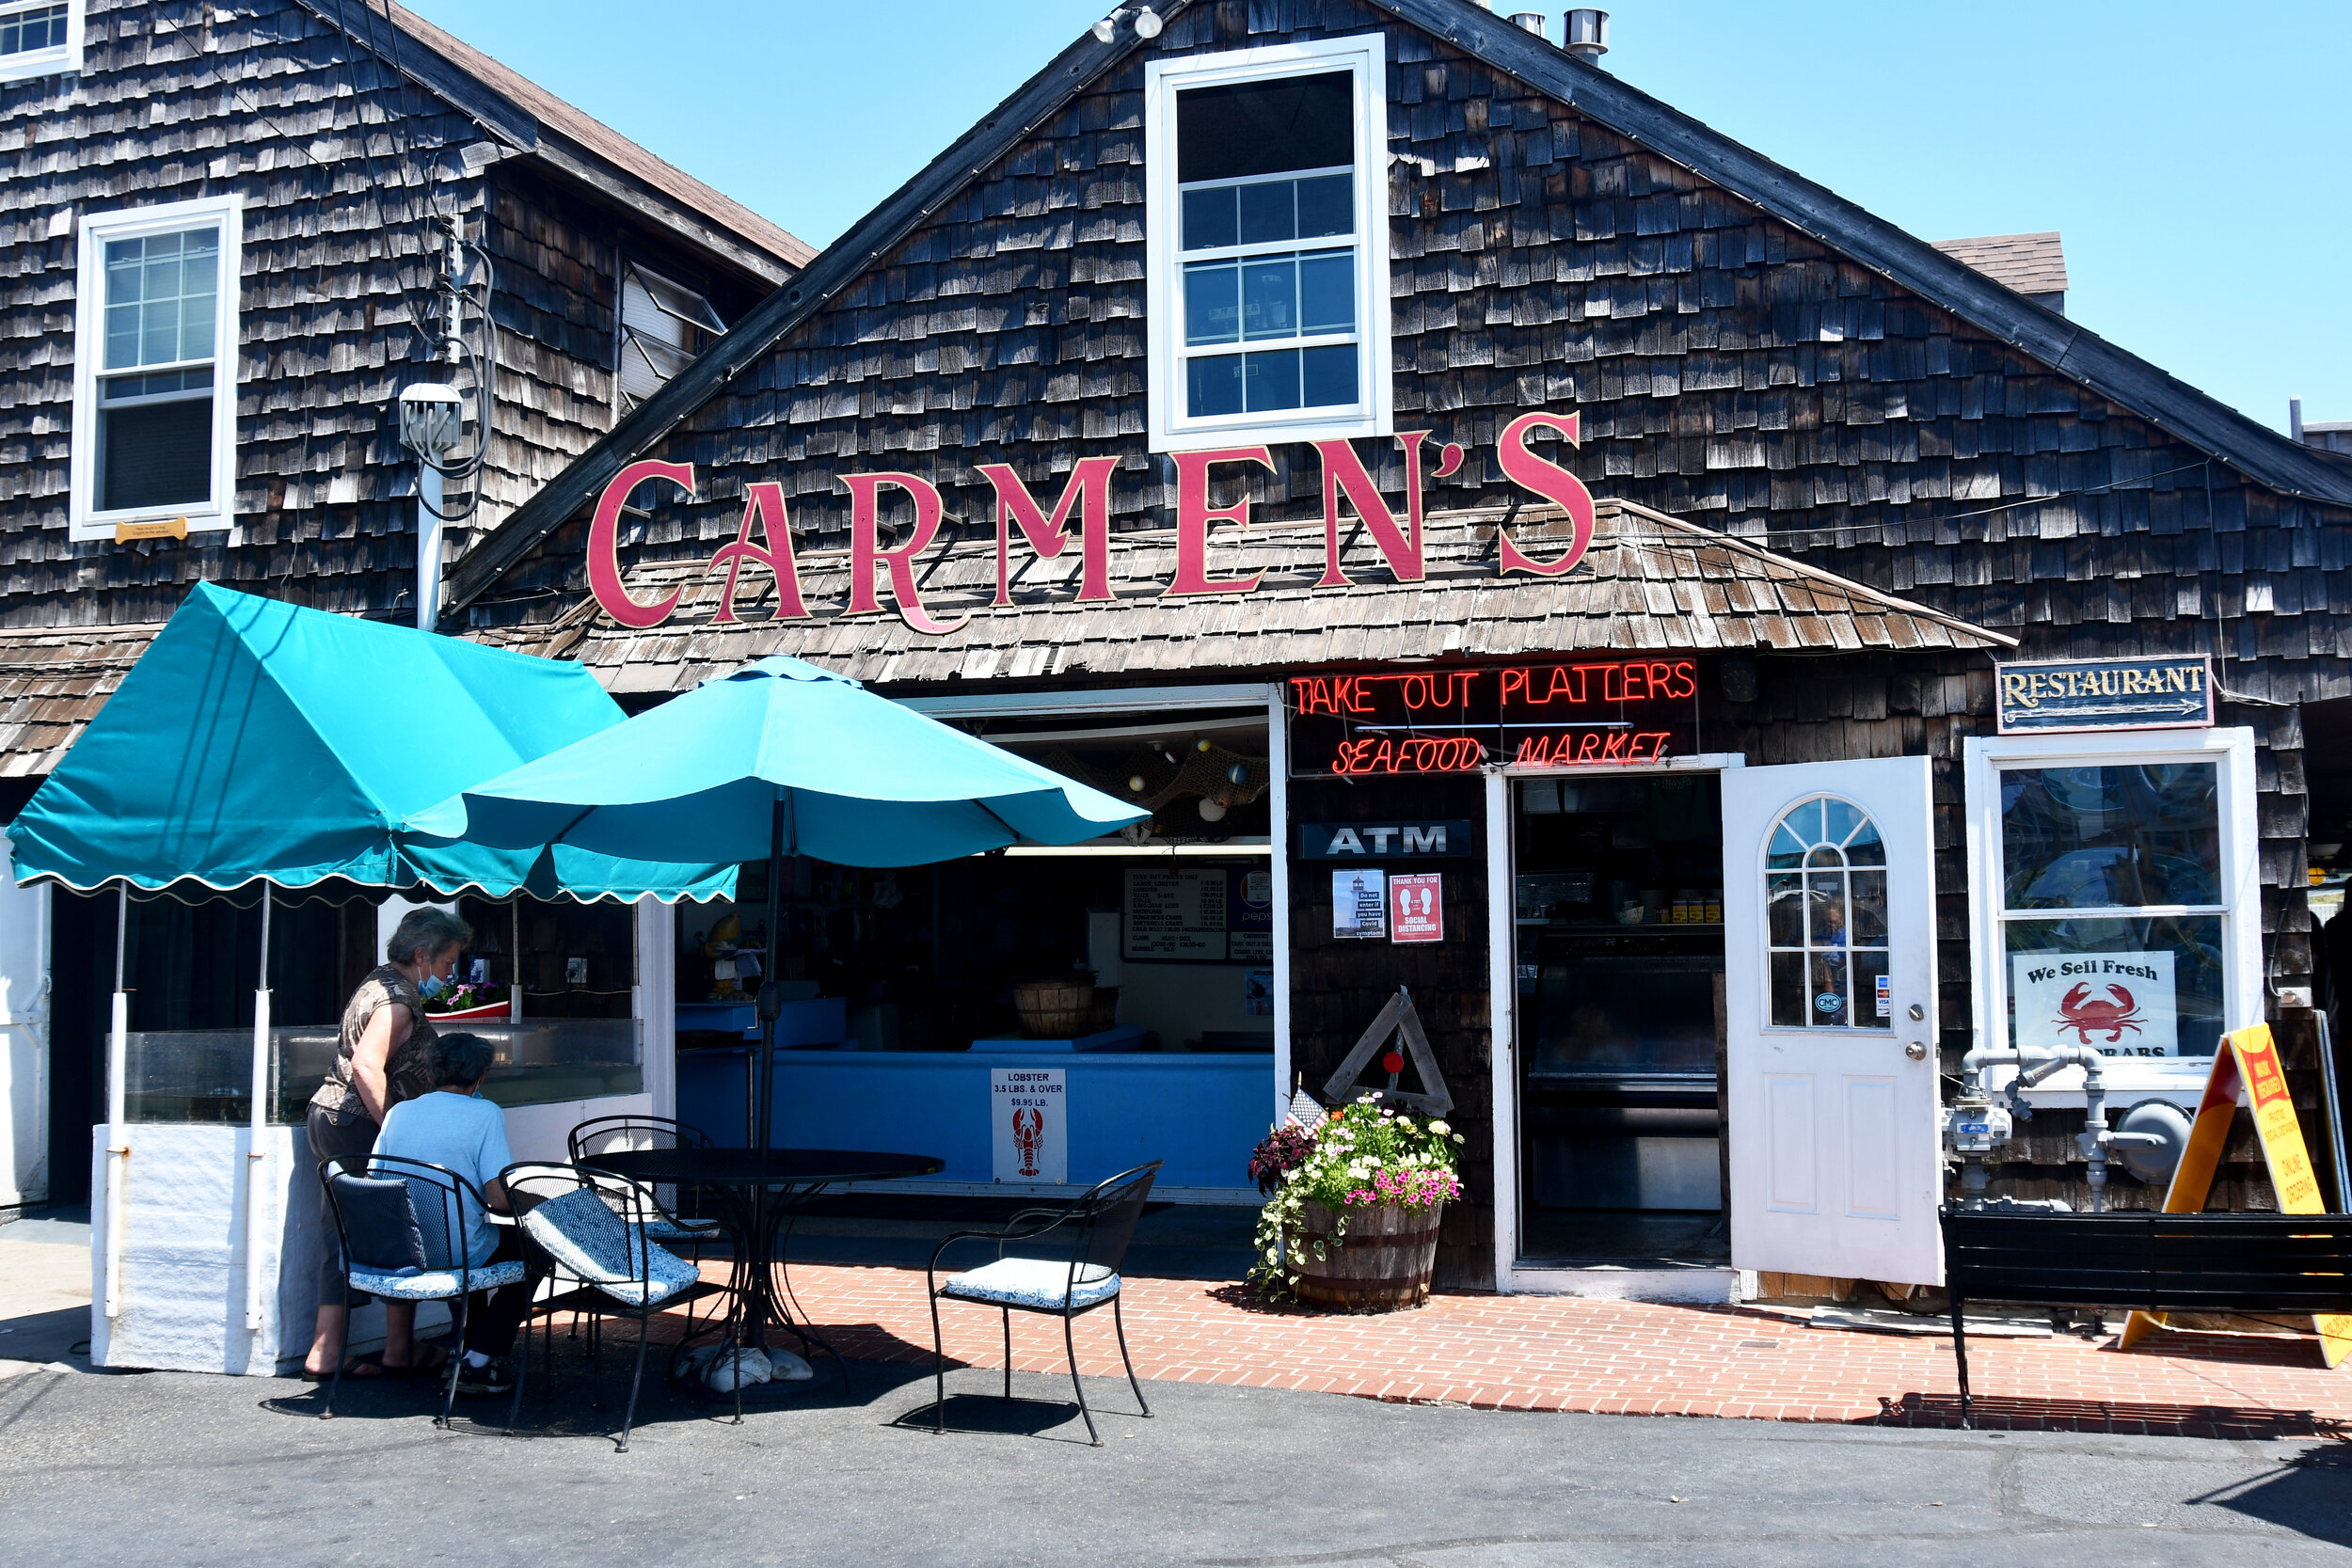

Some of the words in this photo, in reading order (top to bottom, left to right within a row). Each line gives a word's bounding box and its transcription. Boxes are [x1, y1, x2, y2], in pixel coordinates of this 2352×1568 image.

[585, 410, 1596, 635] CARMEN'S
[1291, 675, 1375, 715] TAKE
[1404, 673, 1480, 709] OUT
[1502, 662, 1695, 706] PLATTERS
[2002, 666, 2204, 708] RESTAURANT
[1332, 737, 1482, 774] SEAFOOD
[1516, 733, 1671, 768] MARKET
[1326, 826, 1448, 855] ATM
[1398, 924, 1437, 932] DISTANCING
[1405, 916, 1428, 925] SOCIAL
[2027, 967, 2056, 984] We
[2060, 960, 2098, 976] Sell
[2103, 959, 2158, 981] Fresh
[1008, 1073, 1049, 1082] LOBSTER
[2253, 1060, 2272, 1079] MASK
[994, 1085, 1007, 1093] 3.5
[1009, 1085, 1027, 1093] LBS.
[1029, 1085, 1036, 1093] &
[1038, 1085, 1062, 1093] OVER
[1011, 1098, 1033, 1106] $9.95
[1035, 1099, 1049, 1107] LB.
[2281, 1153, 2303, 1177] ONLINE
[2286, 1176, 2314, 1205] ORDERING
